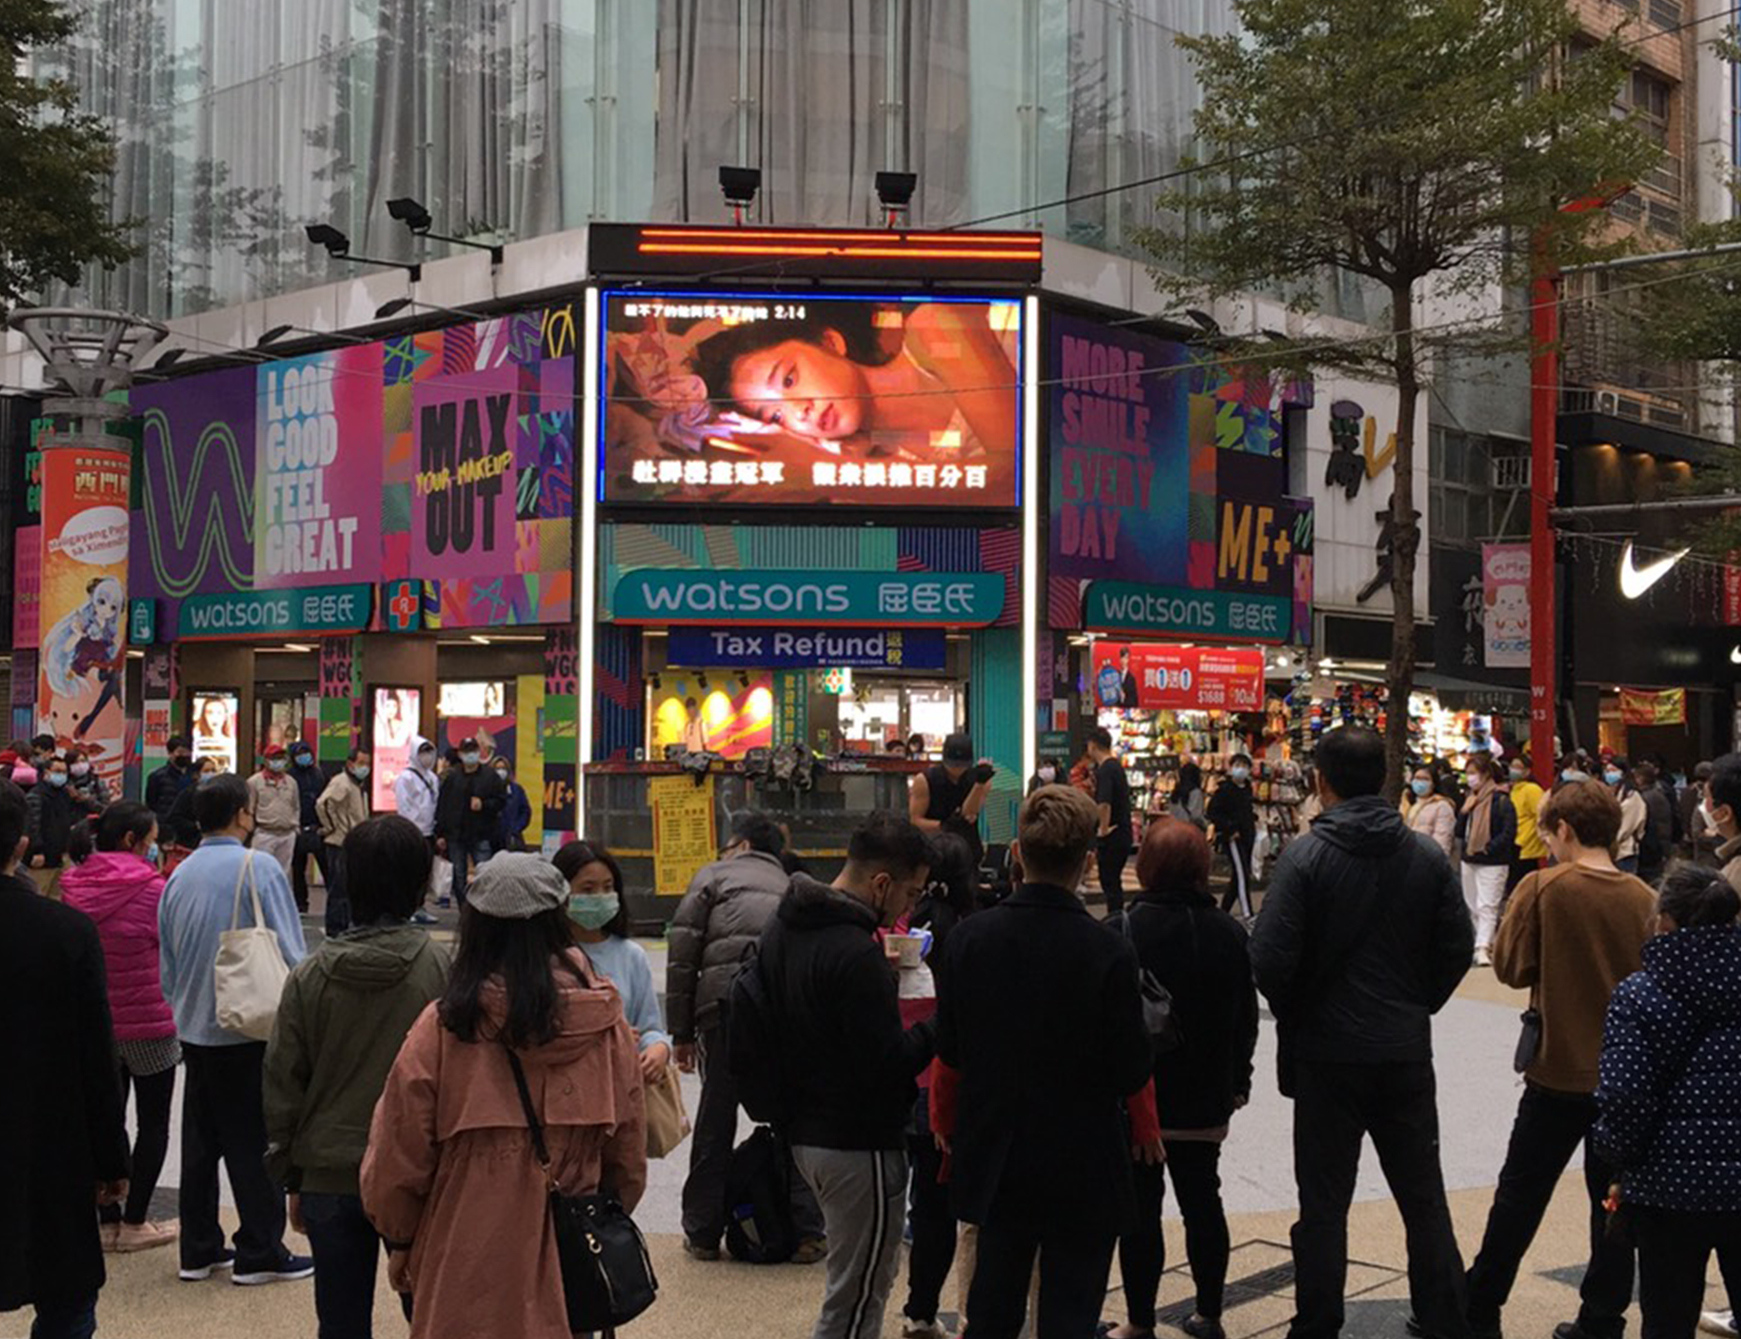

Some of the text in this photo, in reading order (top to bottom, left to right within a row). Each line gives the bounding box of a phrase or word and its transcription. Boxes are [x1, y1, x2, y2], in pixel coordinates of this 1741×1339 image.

[267, 360, 337, 421] LOOK
[1061, 334, 1146, 405] MORE
[265, 414, 338, 472] GOOD
[421, 393, 512, 476] MAX
[1061, 390, 1150, 456] SMILE
[265, 468, 331, 525] FEEL
[416, 450, 514, 498] YOUR MAKEUP
[1061, 447, 1156, 510] EVERY
[426, 474, 502, 556] OUT
[1060, 502, 1121, 561] DAY
[1218, 501, 1291, 583] ME+
[264, 517, 358, 576] GREAT
[191, 594, 355, 628] watsons 屈臣氏
[641, 580, 975, 613] watsons 屈臣氏
[1102, 592, 1278, 632] watsons 屈臣氏
[710, 631, 884, 657] Tax Refund
[1532, 685, 1545, 698] W
[1533, 709, 1546, 721] 13
